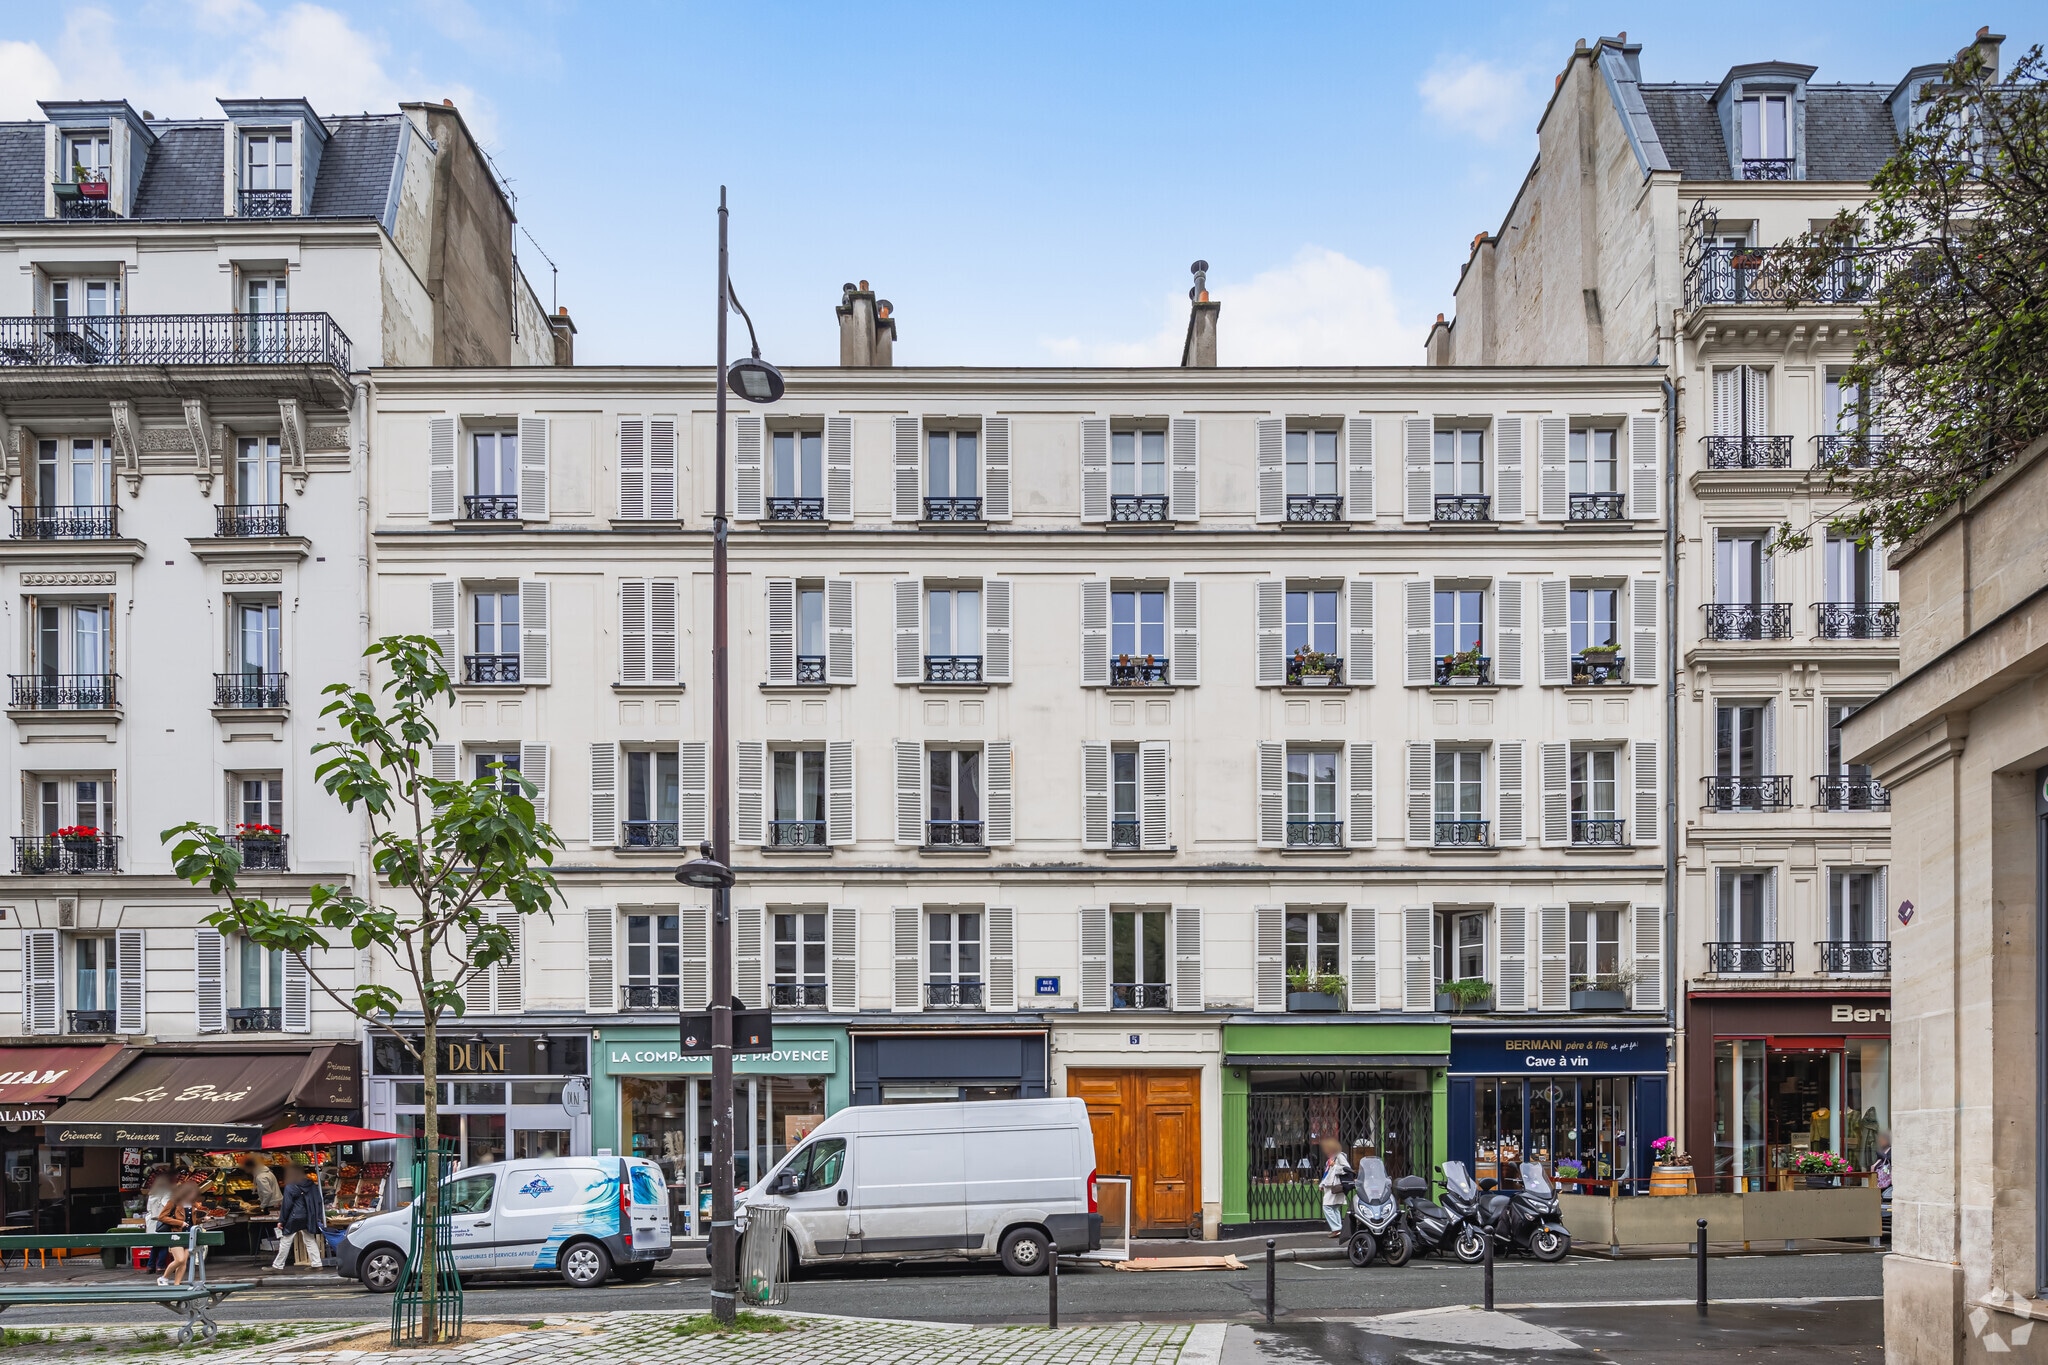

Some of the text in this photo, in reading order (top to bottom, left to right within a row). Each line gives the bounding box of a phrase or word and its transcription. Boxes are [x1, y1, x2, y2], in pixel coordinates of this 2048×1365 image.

[1131, 1036, 1138, 1044] 5
[1505, 1039, 1562, 1051] BERMANI
[1586, 1041, 1593, 1050] &
[1595, 1040, 1609, 1050] fils
[449, 1043, 512, 1071] DUKE
[611, 1052, 631, 1062] LA
[752, 1050, 829, 1061] PROVENCE
[1525, 1055, 1589, 1067] Cave à vin
[1300, 1071, 1337, 1090] NOIR
[115, 1086, 168, 1102] Le
[567, 1091, 581, 1105] DUKE
[60, 1129, 248, 1144] Crèmerie Primeur Epicerie Fine
